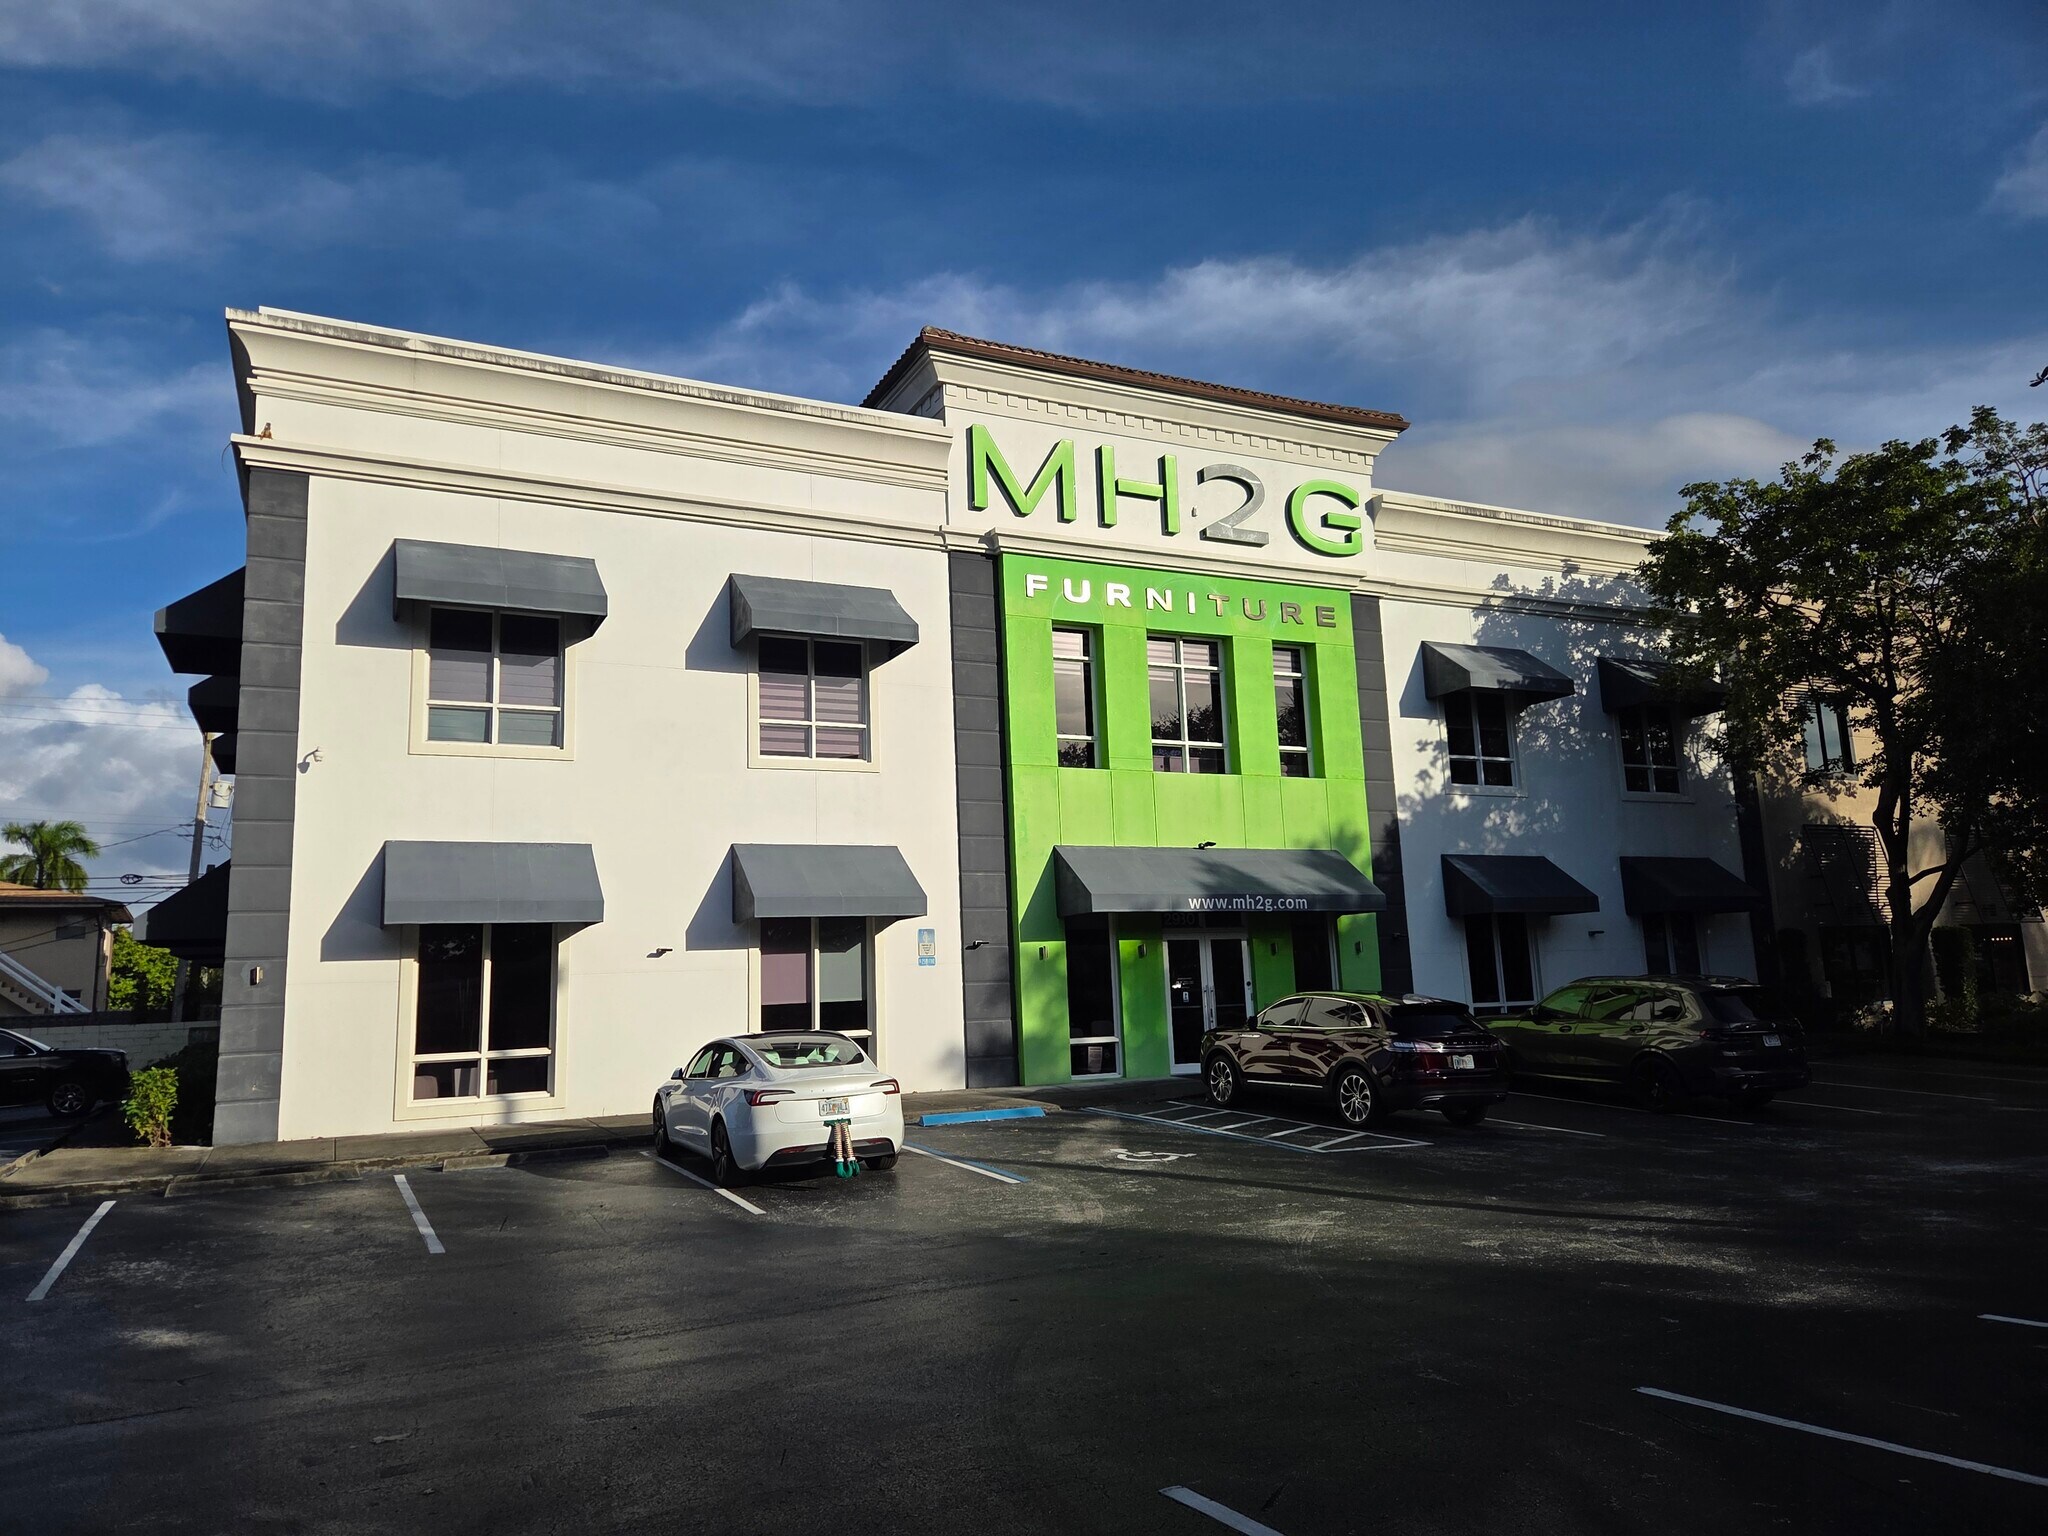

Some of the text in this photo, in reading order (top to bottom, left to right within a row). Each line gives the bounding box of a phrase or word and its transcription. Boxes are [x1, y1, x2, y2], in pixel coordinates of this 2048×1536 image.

[966, 424, 1363, 556] MH2G
[1025, 573, 1337, 627] FURNITURE
[1188, 894, 1308, 912] www.mh2g.com
